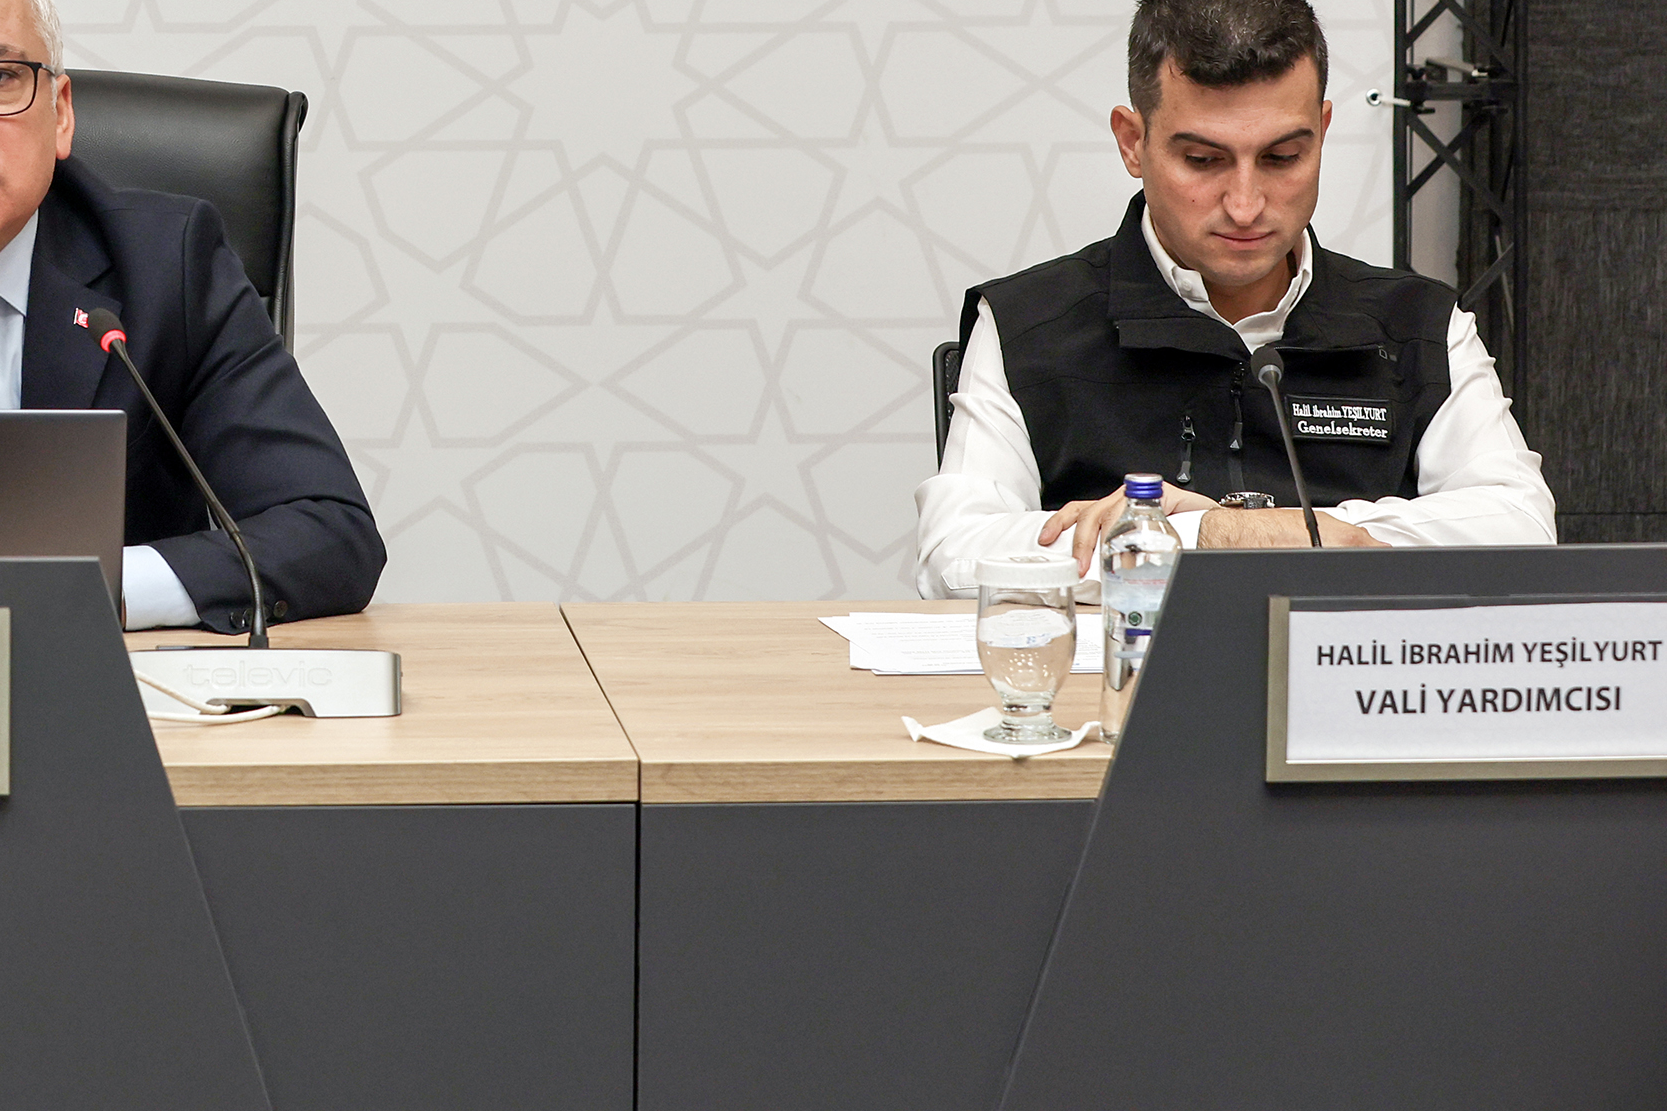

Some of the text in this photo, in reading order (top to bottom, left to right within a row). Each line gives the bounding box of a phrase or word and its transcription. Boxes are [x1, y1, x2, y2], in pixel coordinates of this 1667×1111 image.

[1316, 637, 1663, 667] HALİL İBRAHİM YEŞİLYURT
[184, 660, 334, 688] televic
[1356, 683, 1621, 715] VALİ YARDIMCISI
